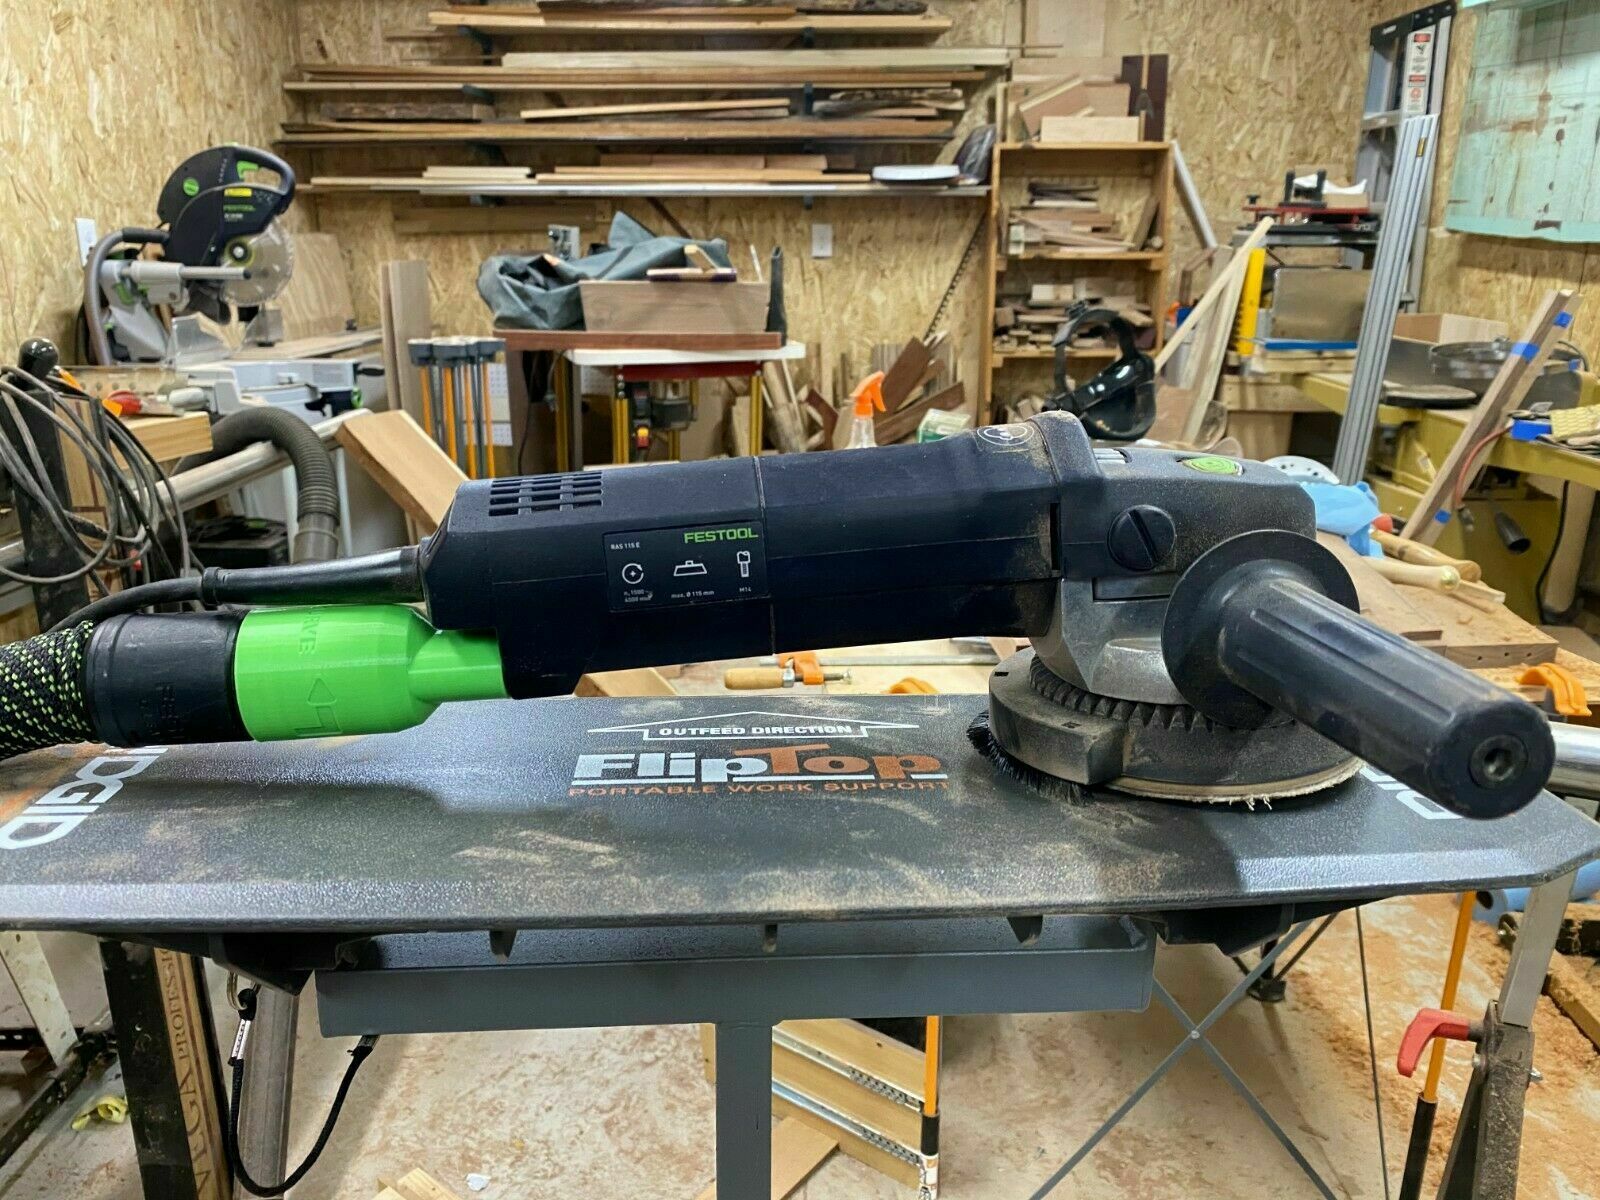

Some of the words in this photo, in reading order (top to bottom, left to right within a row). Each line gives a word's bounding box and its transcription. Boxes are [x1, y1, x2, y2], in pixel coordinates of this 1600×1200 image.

[684, 527, 759, 544] FESTOOL
[659, 727, 746, 736] OUTFEED
[751, 725, 852, 735] DIRECTION
[568, 785, 717, 797] PORTABLE
[727, 783, 814, 795] WORK
[823, 781, 950, 793] SUPPORT
[0, 745, 169, 850] IDGID
